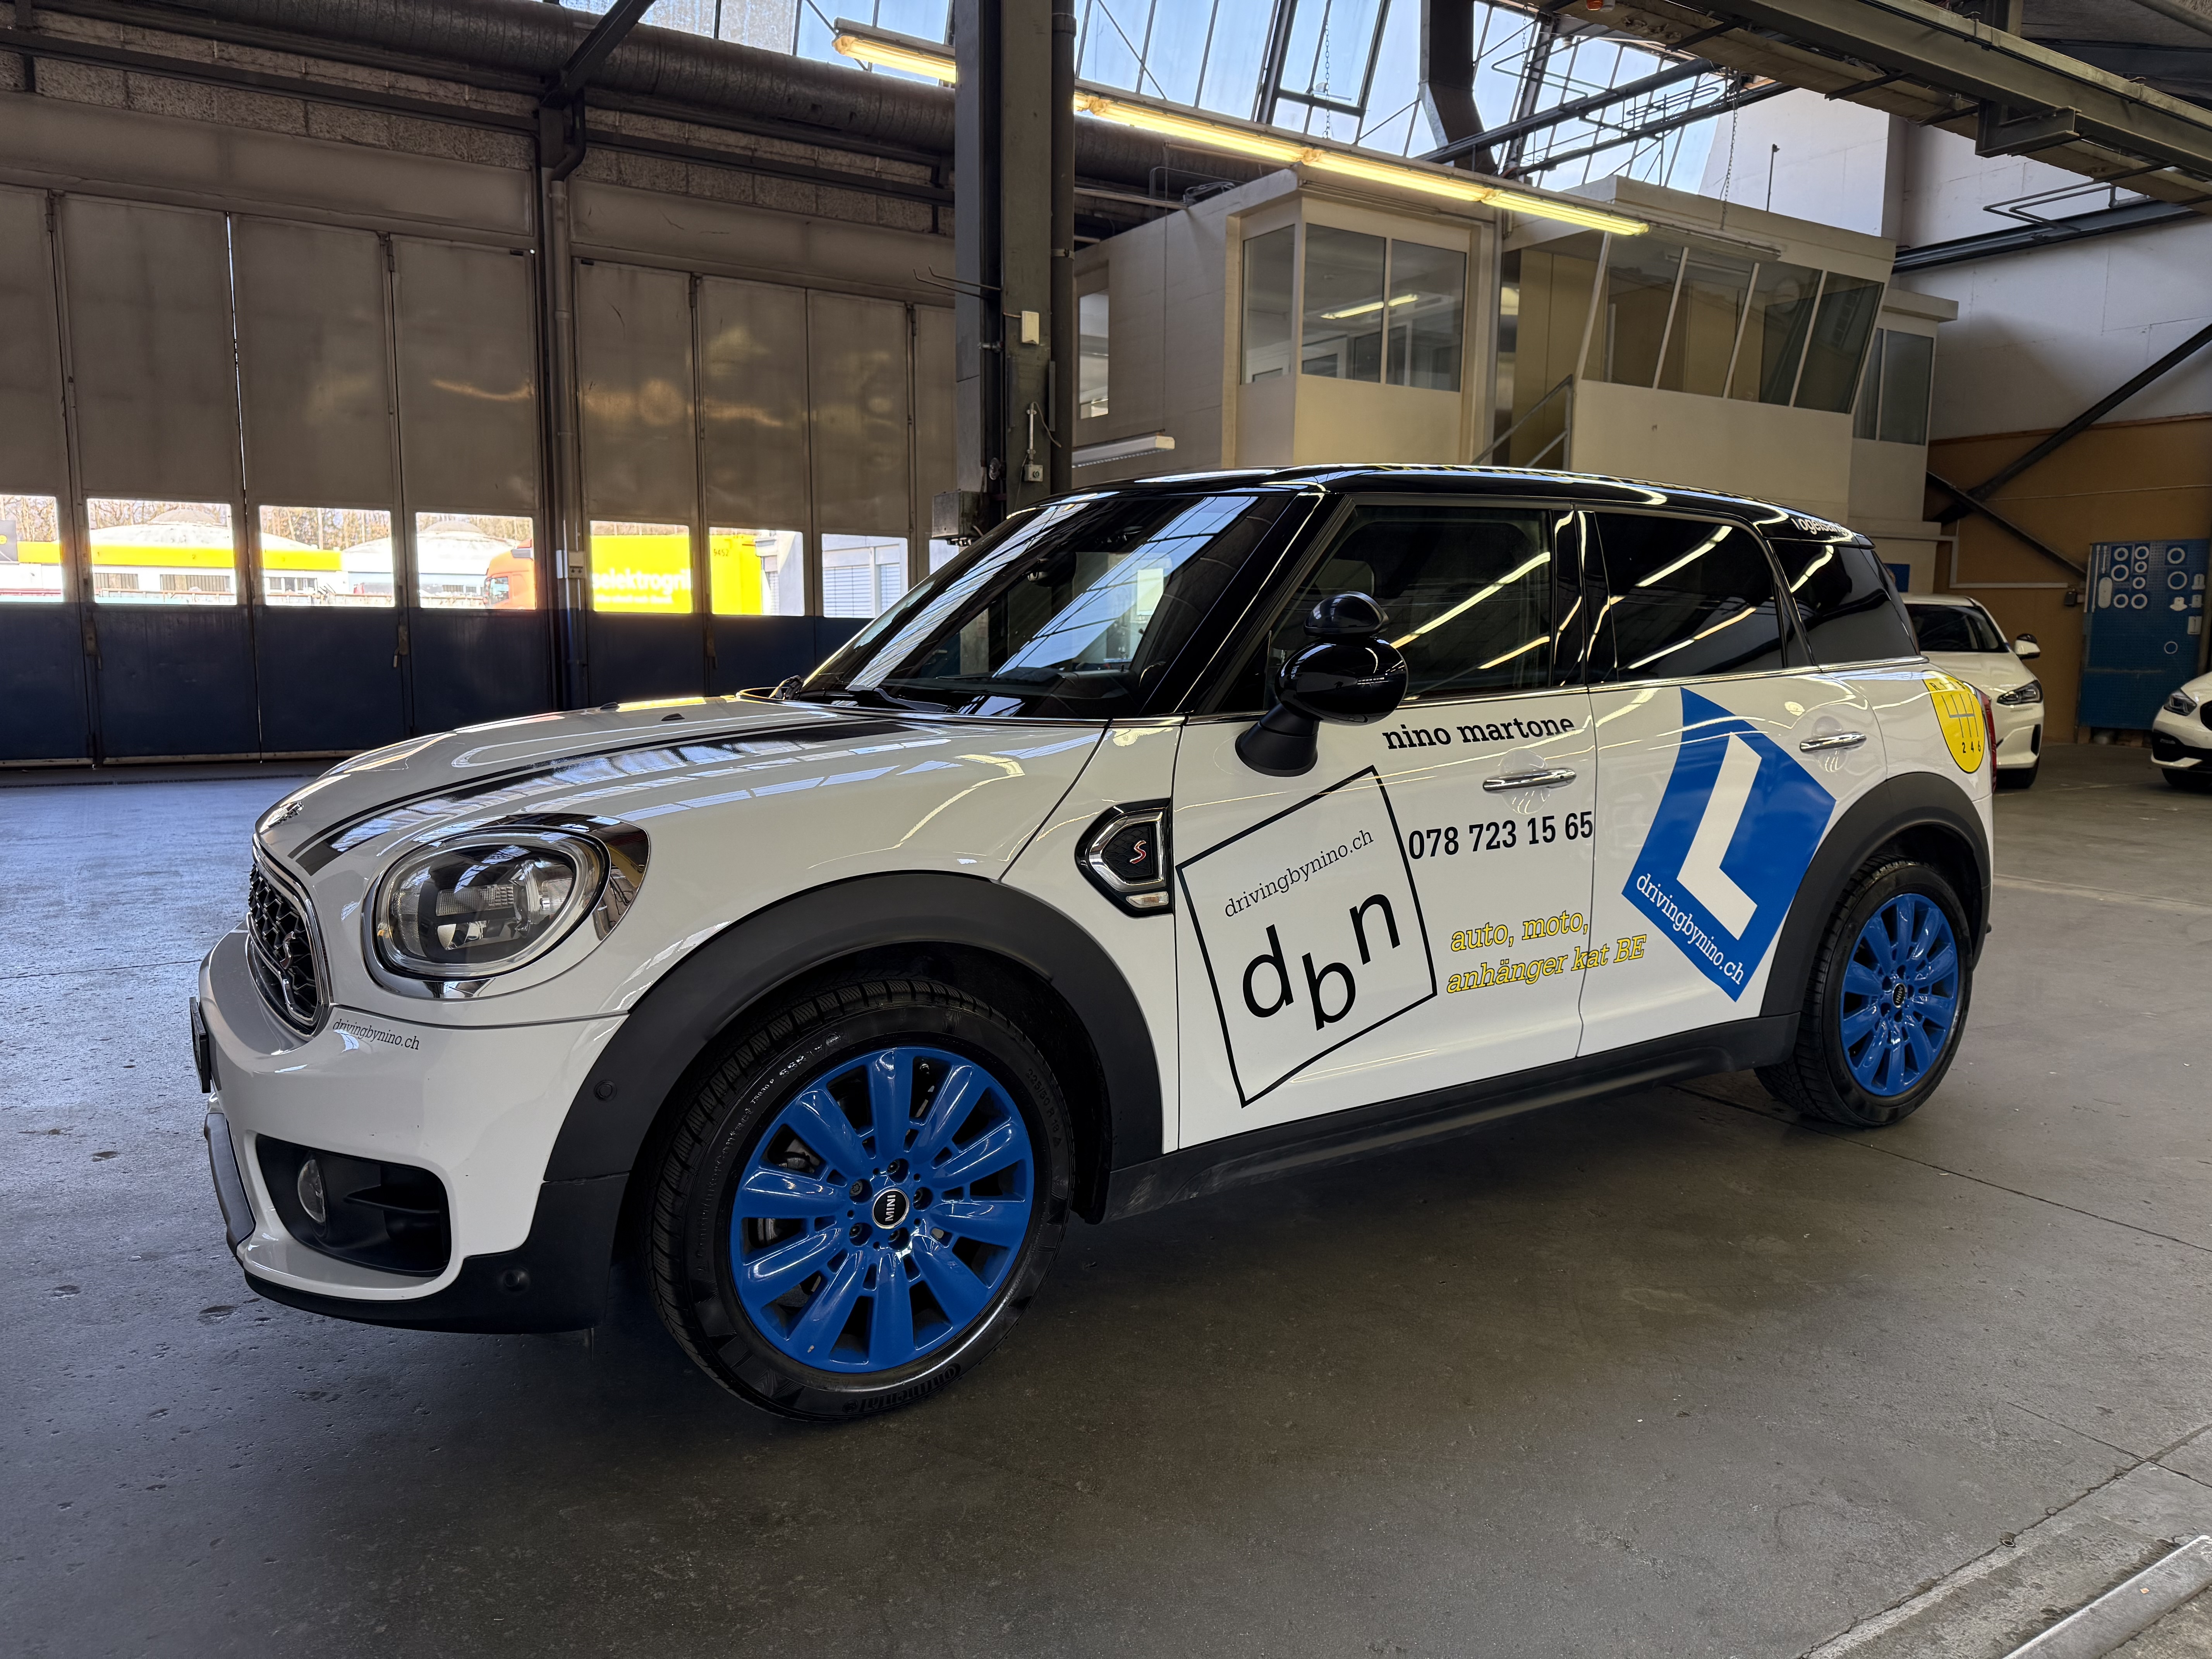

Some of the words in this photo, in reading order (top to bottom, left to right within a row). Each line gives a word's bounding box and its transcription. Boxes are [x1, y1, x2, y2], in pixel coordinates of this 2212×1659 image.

[1382, 724, 1451, 750] nino
[1456, 718, 1576, 743] martone
[1961, 742, 1966, 754] 2
[1970, 741, 1975, 753] 4
[1977, 740, 1981, 752] 6
[1129, 840, 1147, 864] S
[1408, 826, 1459, 859] 078
[1468, 819, 1516, 852] 723
[1527, 815, 1556, 845] 15
[1565, 811, 1593, 840] 65
[1676, 732, 1762, 941] L
[1224, 830, 1374, 917] drivingbynino.ch
[1450, 922, 1514, 952] auto,
[1522, 910, 1589, 941] moto,
[1636, 873, 1744, 985] drivingbynino.ch
[1446, 954, 1569, 994] anhänger
[1570, 943, 1610, 971] kat
[1613, 933, 1647, 963] BE
[1895, 985, 1903, 1004] MINI
[333, 1018, 420, 1050] drivingbynino.ch
[885, 1195, 896, 1222] MINI
